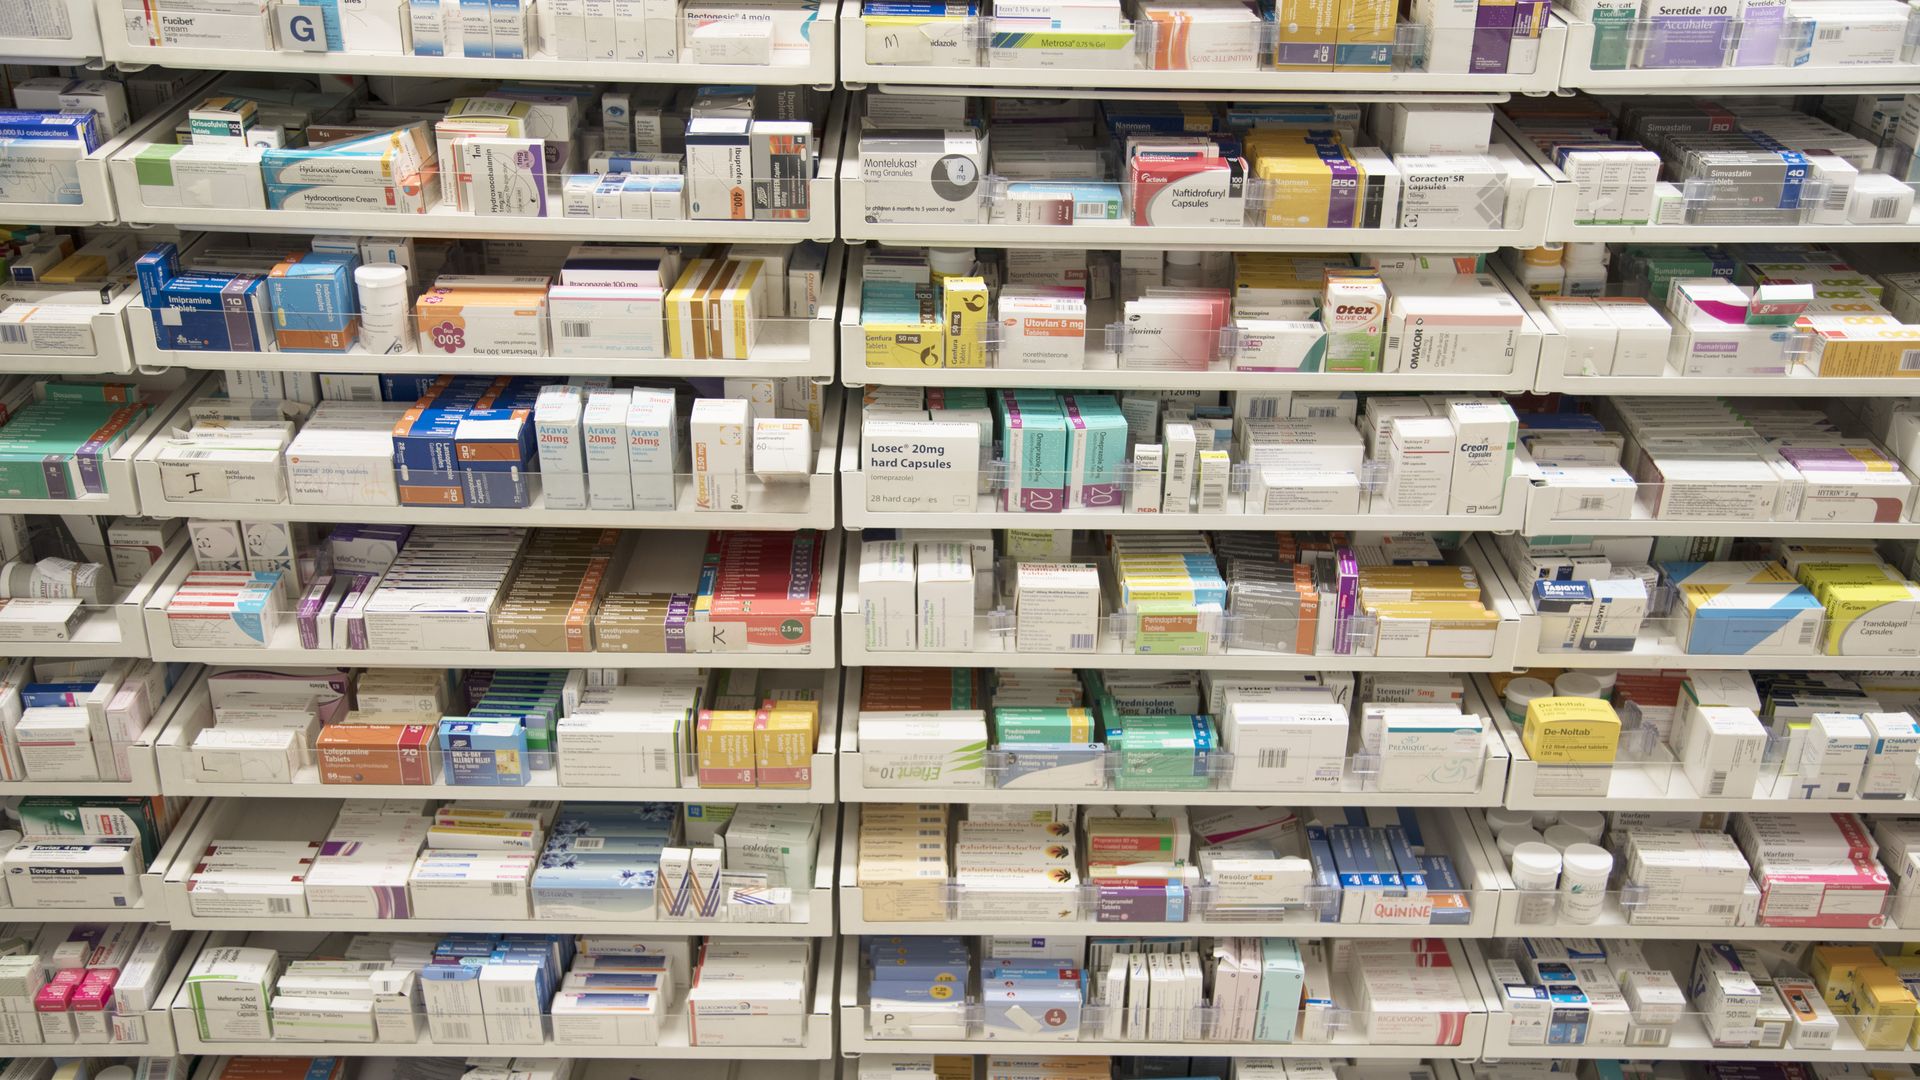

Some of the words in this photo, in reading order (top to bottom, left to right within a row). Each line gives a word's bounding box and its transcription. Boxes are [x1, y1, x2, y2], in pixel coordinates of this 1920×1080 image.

[1708, 6, 1728, 15] 100
[290, 16, 315, 42] G
[885, 34, 899, 48] M
[1321, 46, 1329, 63] 30
[1379, 48, 1388, 61] 15
[1713, 124, 1730, 132] 80
[472, 144, 482, 159] 1ml
[864, 159, 917, 170] Montelukast
[959, 165, 964, 174] 4
[300, 166, 350, 175] Hydrocortisone
[1711, 170, 1752, 178] Simvastatin
[487, 148, 498, 213] Hydroxocobalamin
[1408, 184, 1447, 192] capsules
[1173, 188, 1226, 199] Naftidrofuryl
[304, 194, 353, 204] Hydrocortisone
[1172, 200, 1209, 210] Capsules
[1010, 271, 1059, 280] Norethisterone
[1713, 268, 1733, 276] 100
[168, 296, 212, 306] Imipramine
[170, 304, 197, 313] Tablets
[1336, 304, 1374, 316] Otex
[952, 324, 960, 334] 50
[1062, 320, 1067, 328] 5
[1069, 321, 1084, 330] mg
[330, 334, 339, 348] 50
[438, 334, 463, 346] 300
[866, 334, 892, 342] Genfura
[866, 342, 888, 351] Tablets
[951, 339, 959, 364] Genfura
[1410, 329, 1423, 369] OMACOR
[1696, 343, 1736, 351] Sumatriptan
[486, 348, 500, 356] 300
[501, 348, 538, 357] Irbesartan
[1023, 351, 1068, 359] norethisterone
[540, 426, 568, 436] Arava
[588, 426, 616, 436] Arava
[630, 428, 659, 438] Arava
[540, 436, 569, 446] 20mg
[588, 436, 617, 445] 20mg
[632, 437, 660, 448] 20mg
[913, 444, 945, 458] 20mg
[872, 458, 897, 468] hard
[900, 458, 952, 471] Capsules
[871, 474, 914, 484] (omeprazole)
[449, 488, 458, 502] 30
[730, 494, 739, 504] 60
[871, 495, 881, 503] 28
[883, 494, 899, 503] hard
[1090, 486, 1112, 507] 20
[1030, 490, 1053, 512] 20
[1594, 604, 1606, 635] FASIGYN
[1862, 620, 1908, 630] Trandolapril
[712, 626, 726, 646] K
[782, 626, 792, 634] 2.5
[792, 627, 804, 636] mg
[1860, 628, 1893, 637] Capsules
[1417, 689, 1434, 698] 5mg
[1116, 700, 1174, 708] Prednisolone
[324, 748, 368, 757] Lofepramine
[203, 753, 218, 772] L
[881, 768, 896, 780] 10
[897, 766, 941, 781] Efient
[1802, 784, 1820, 800] T
[66, 869, 80, 877] mg
[885, 1014, 894, 1024] P
